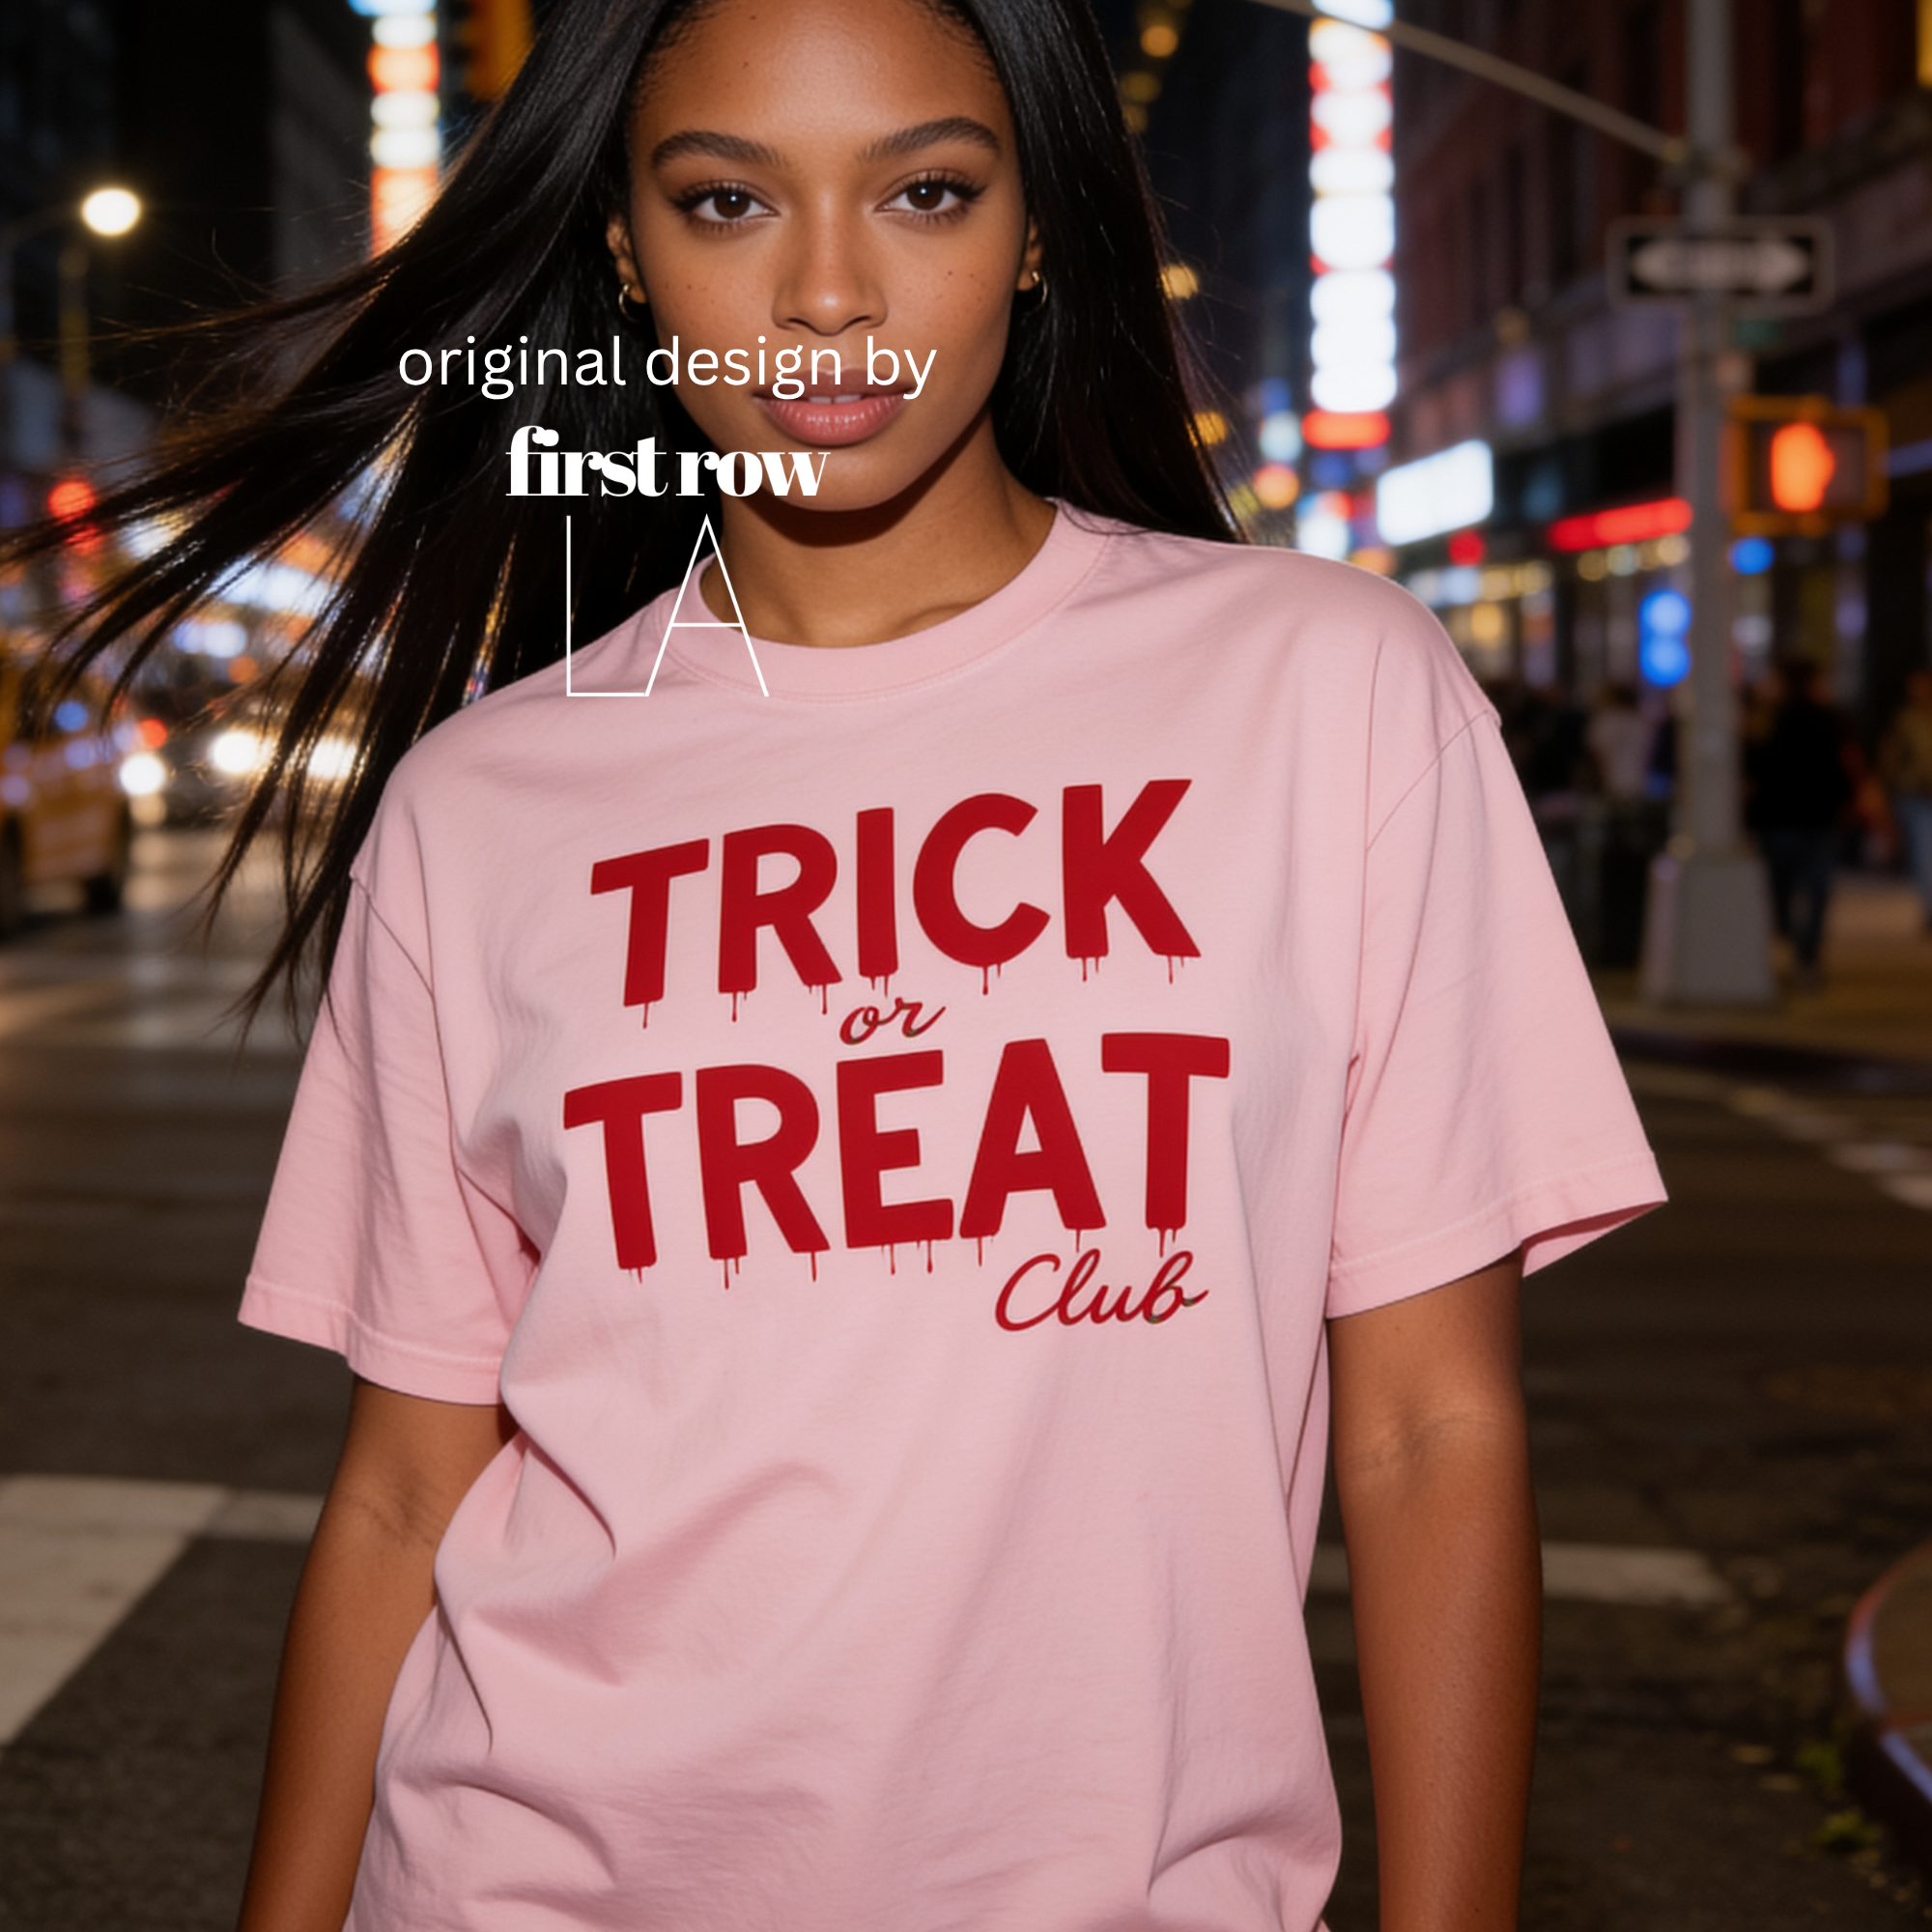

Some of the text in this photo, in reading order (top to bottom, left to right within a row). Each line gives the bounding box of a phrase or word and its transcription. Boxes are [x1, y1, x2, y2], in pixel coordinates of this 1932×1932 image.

[590, 779, 1201, 1030] TRICK
[838, 996, 947, 1046] or
[563, 1032, 1231, 1291] TREAT
[995, 1248, 1209, 1333] Club
